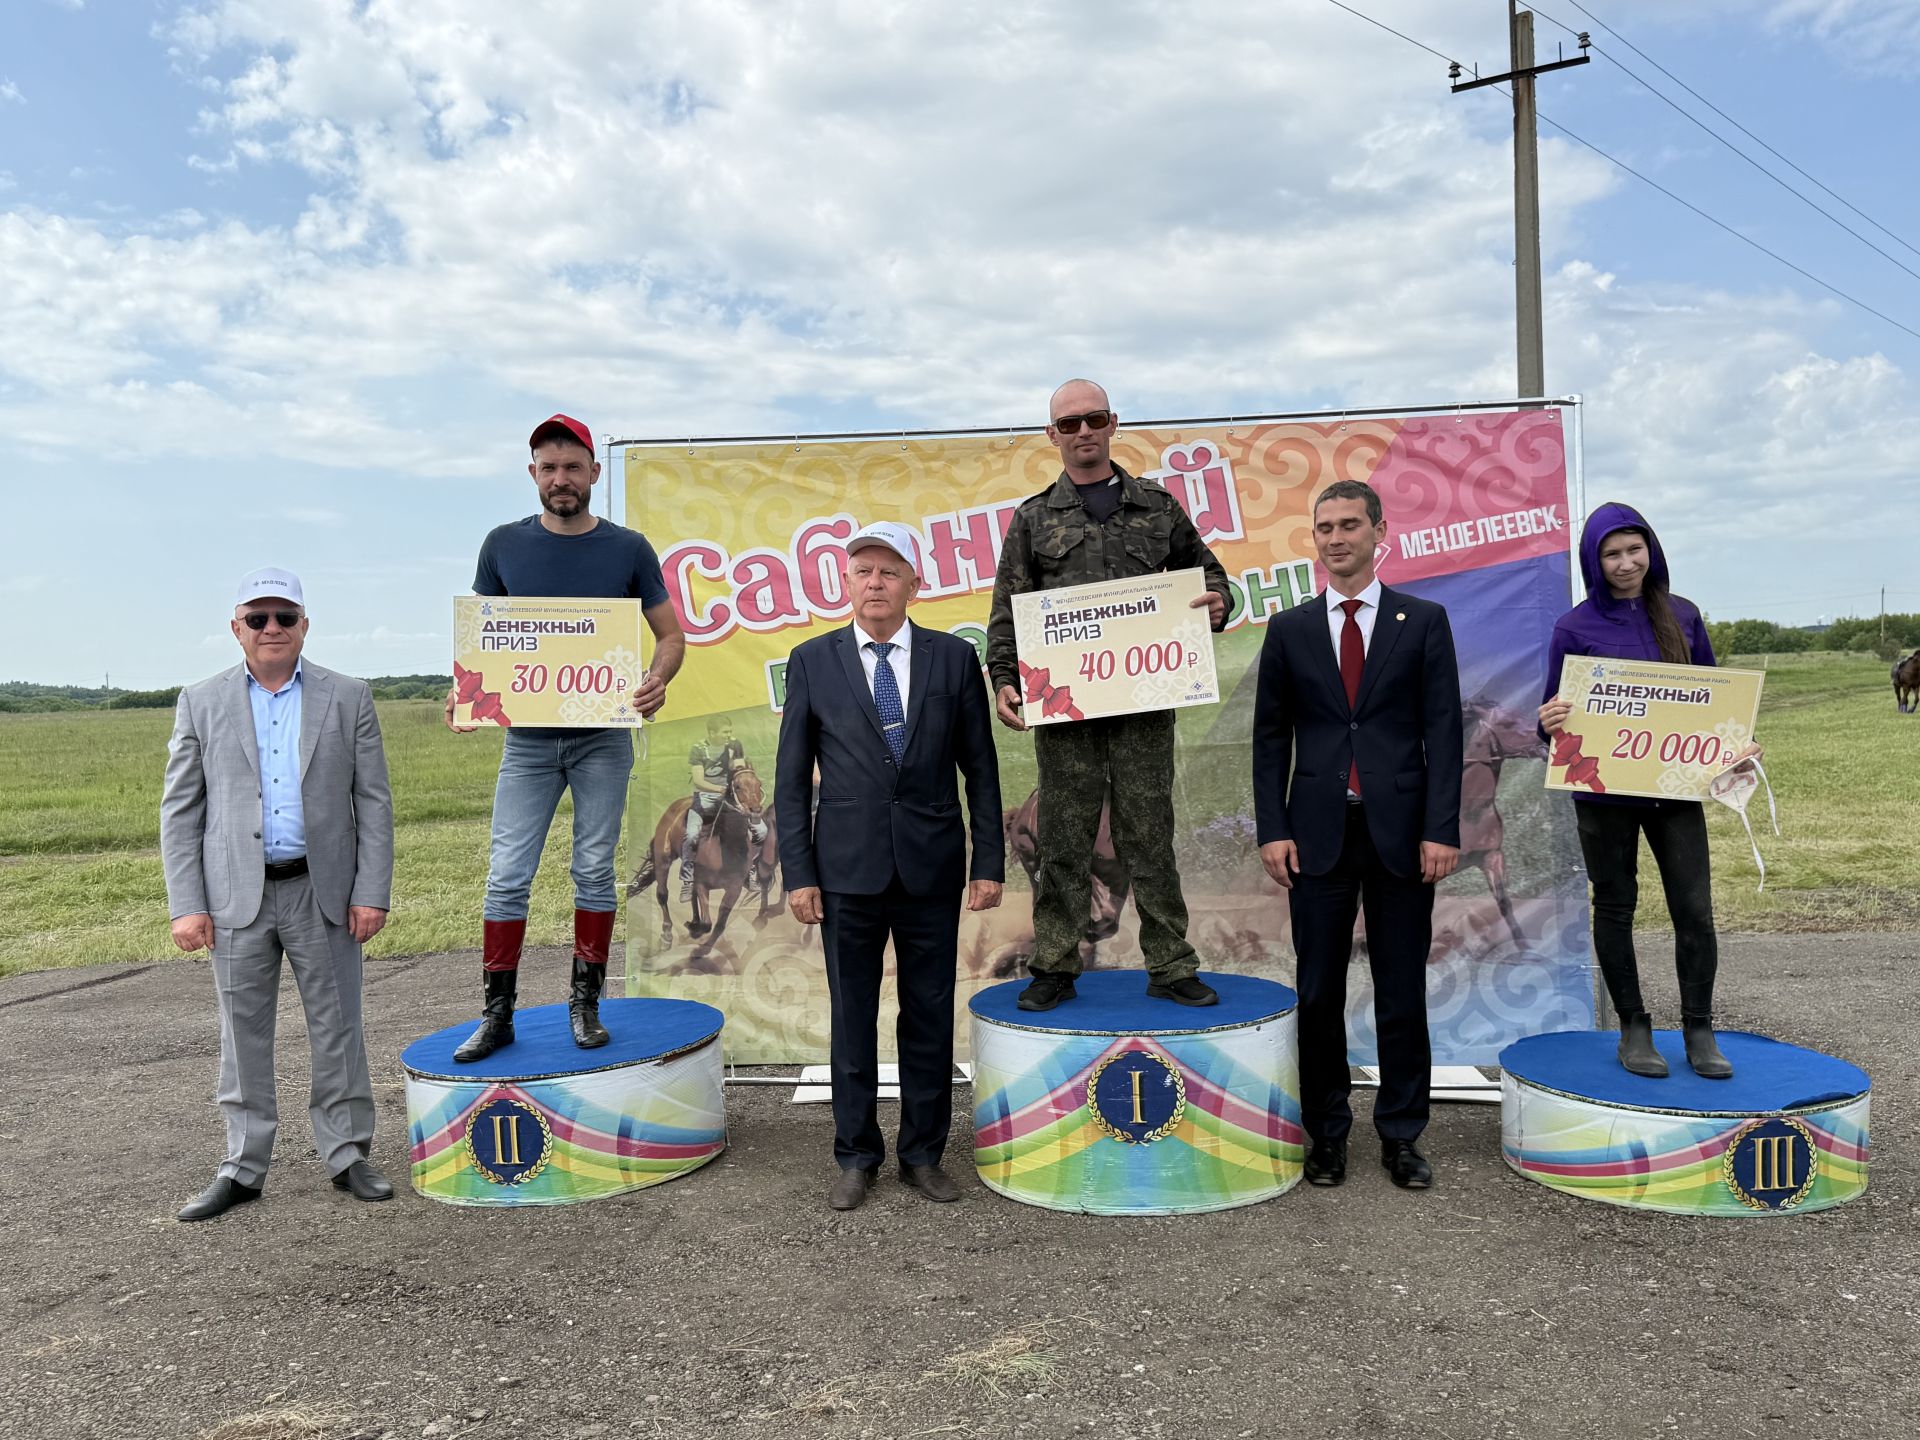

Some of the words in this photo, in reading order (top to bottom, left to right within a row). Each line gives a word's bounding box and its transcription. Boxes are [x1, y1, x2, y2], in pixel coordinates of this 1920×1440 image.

[1399, 504, 1561, 559] МЕНДЕЛЕЕВСК
[482, 618, 595, 634] ДЕНЕЖНЫЙ
[1044, 596, 1157, 629] ДЕНЕЖНЫЙ
[482, 636, 538, 650] ПРИЗ
[1045, 624, 1101, 645] ПРИЗ
[511, 664, 548, 694] 30
[1079, 650, 1115, 682] 40
[1586, 699, 1647, 716] ПРИЗ
[1589, 683, 1711, 704] ДЕНЕЖНЫЙ
[1612, 728, 1652, 760] 20
[1127, 1070, 1148, 1125] I
[488, 1115, 524, 1164] II
[1750, 1135, 1798, 1191] III
